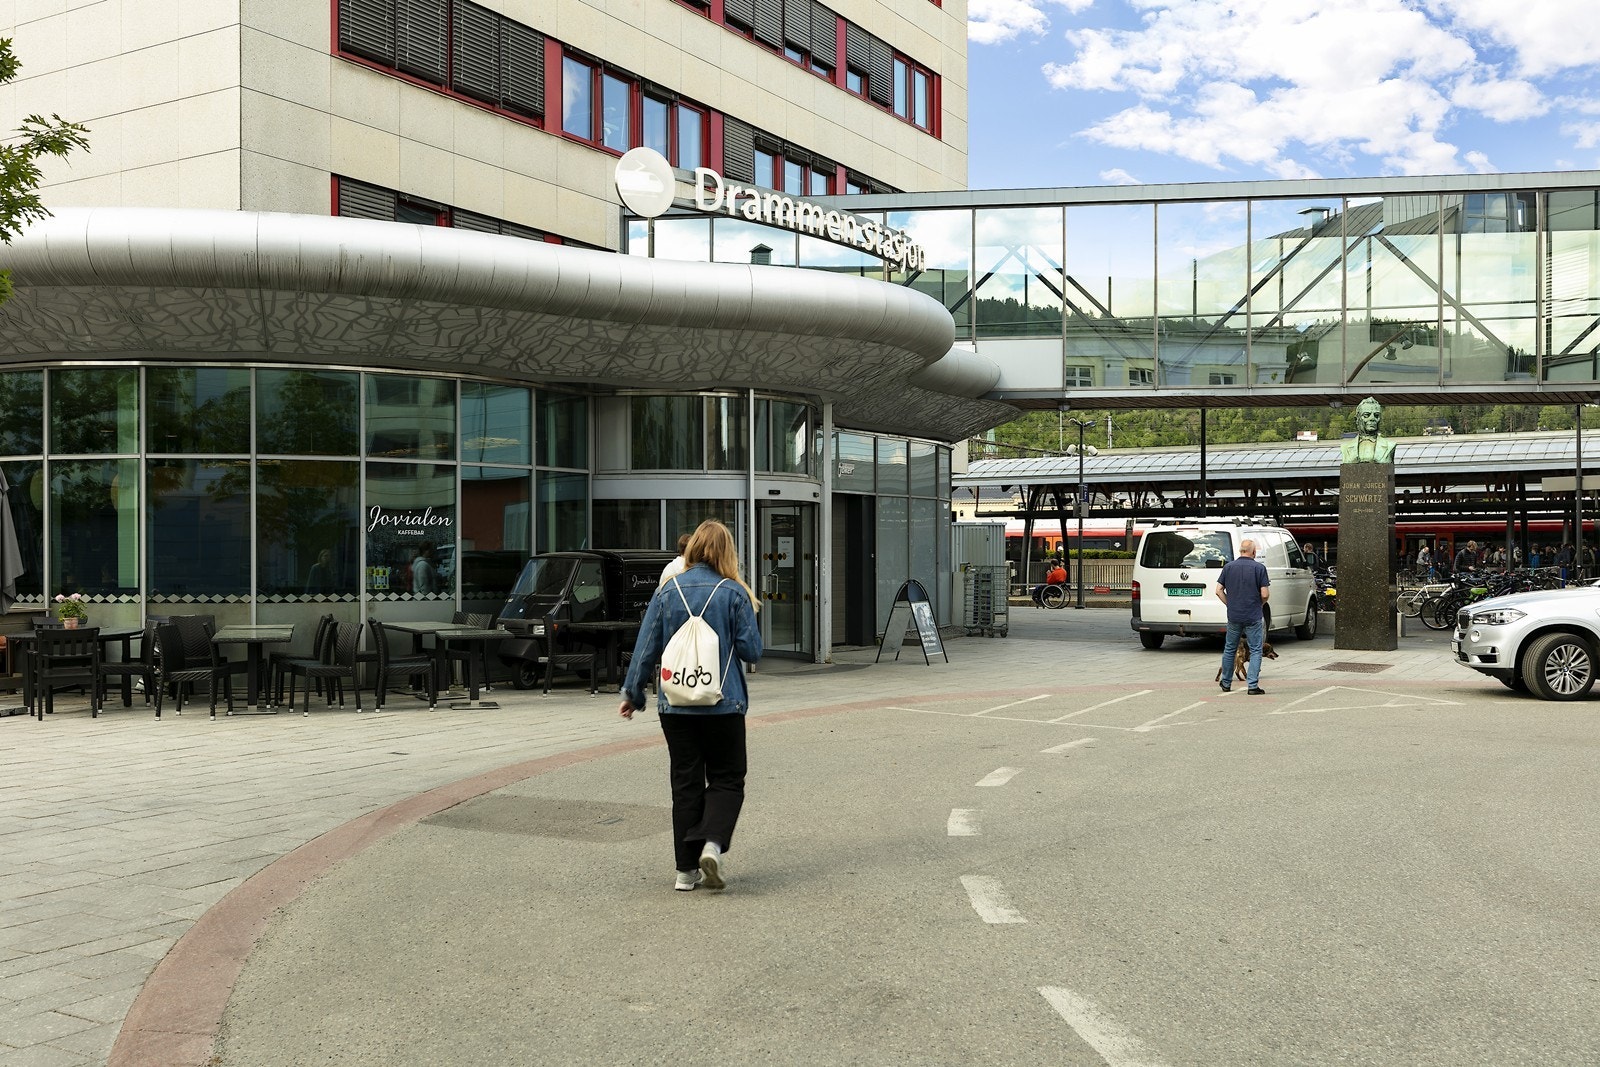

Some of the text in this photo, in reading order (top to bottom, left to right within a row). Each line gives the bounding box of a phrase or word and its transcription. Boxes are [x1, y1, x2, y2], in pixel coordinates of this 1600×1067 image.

[695, 167, 927, 274] Drammen stasjon
[1345, 494, 1382, 503] SCHWARTZ
[367, 504, 453, 533] Jovialen
